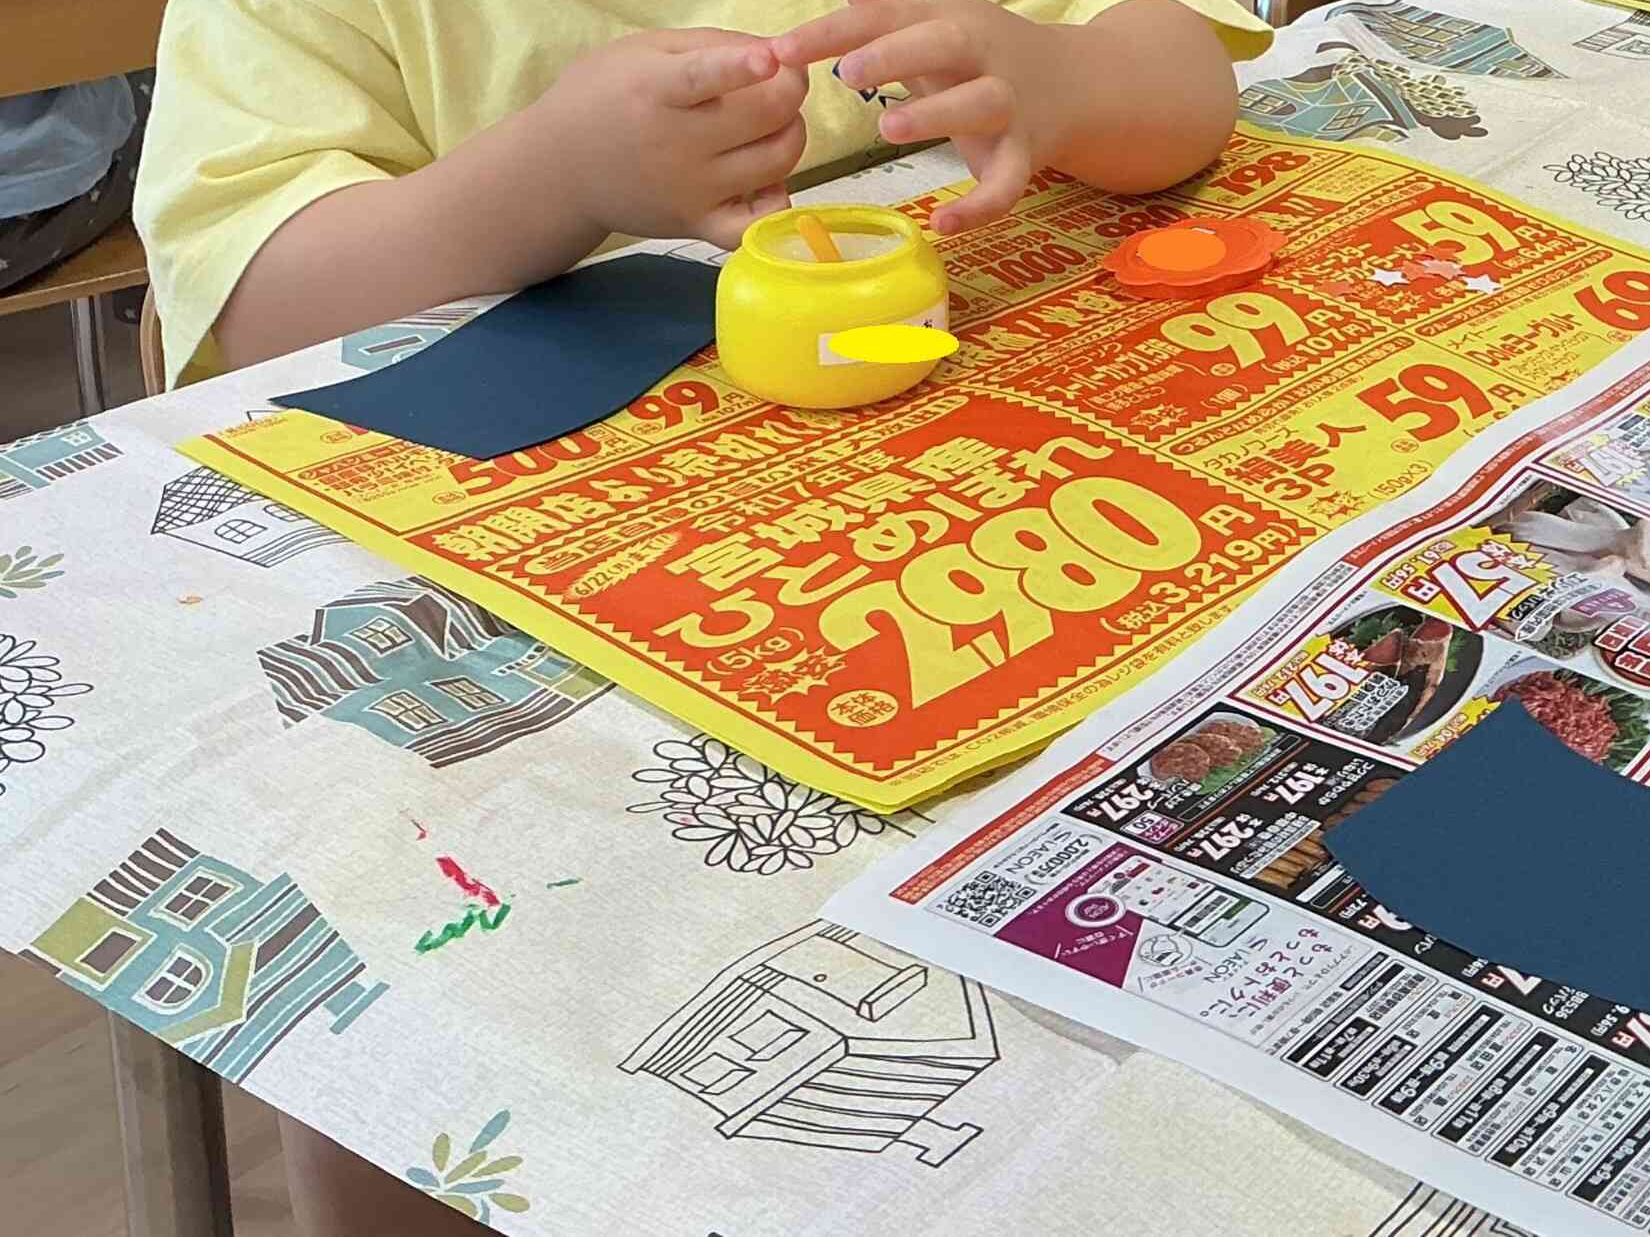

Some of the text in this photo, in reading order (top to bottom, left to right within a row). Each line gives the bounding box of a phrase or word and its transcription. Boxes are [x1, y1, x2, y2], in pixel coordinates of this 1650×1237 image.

[1208, 148, 1320, 196] 198
[964, 241, 1104, 290] 1000
[1022, 341, 1129, 387] エースコック
[1255, 319, 1378, 374] (税込107円)
[1461, 309, 1591, 366] Doleヨーグルト
[1197, 425, 1302, 470] タカノフーズ
[1217, 415, 1371, 487] 絹美人
[684, 447, 907, 537] 令和7年度
[1255, 460, 1353, 503] 3P
[655, 433, 1015, 593] 宮城県産
[646, 431, 1121, 657] ひとめぼれ
[1095, 520, 1301, 637] (税込3,219円)
[703, 625, 811, 677] (5kg)
[826, 691, 880, 717] 本体
[844, 699, 899, 726] 価格
[1193, 926, 1323, 1021] もっとおトクに。
[1221, 941, 1337, 1024] もっと便利に、
